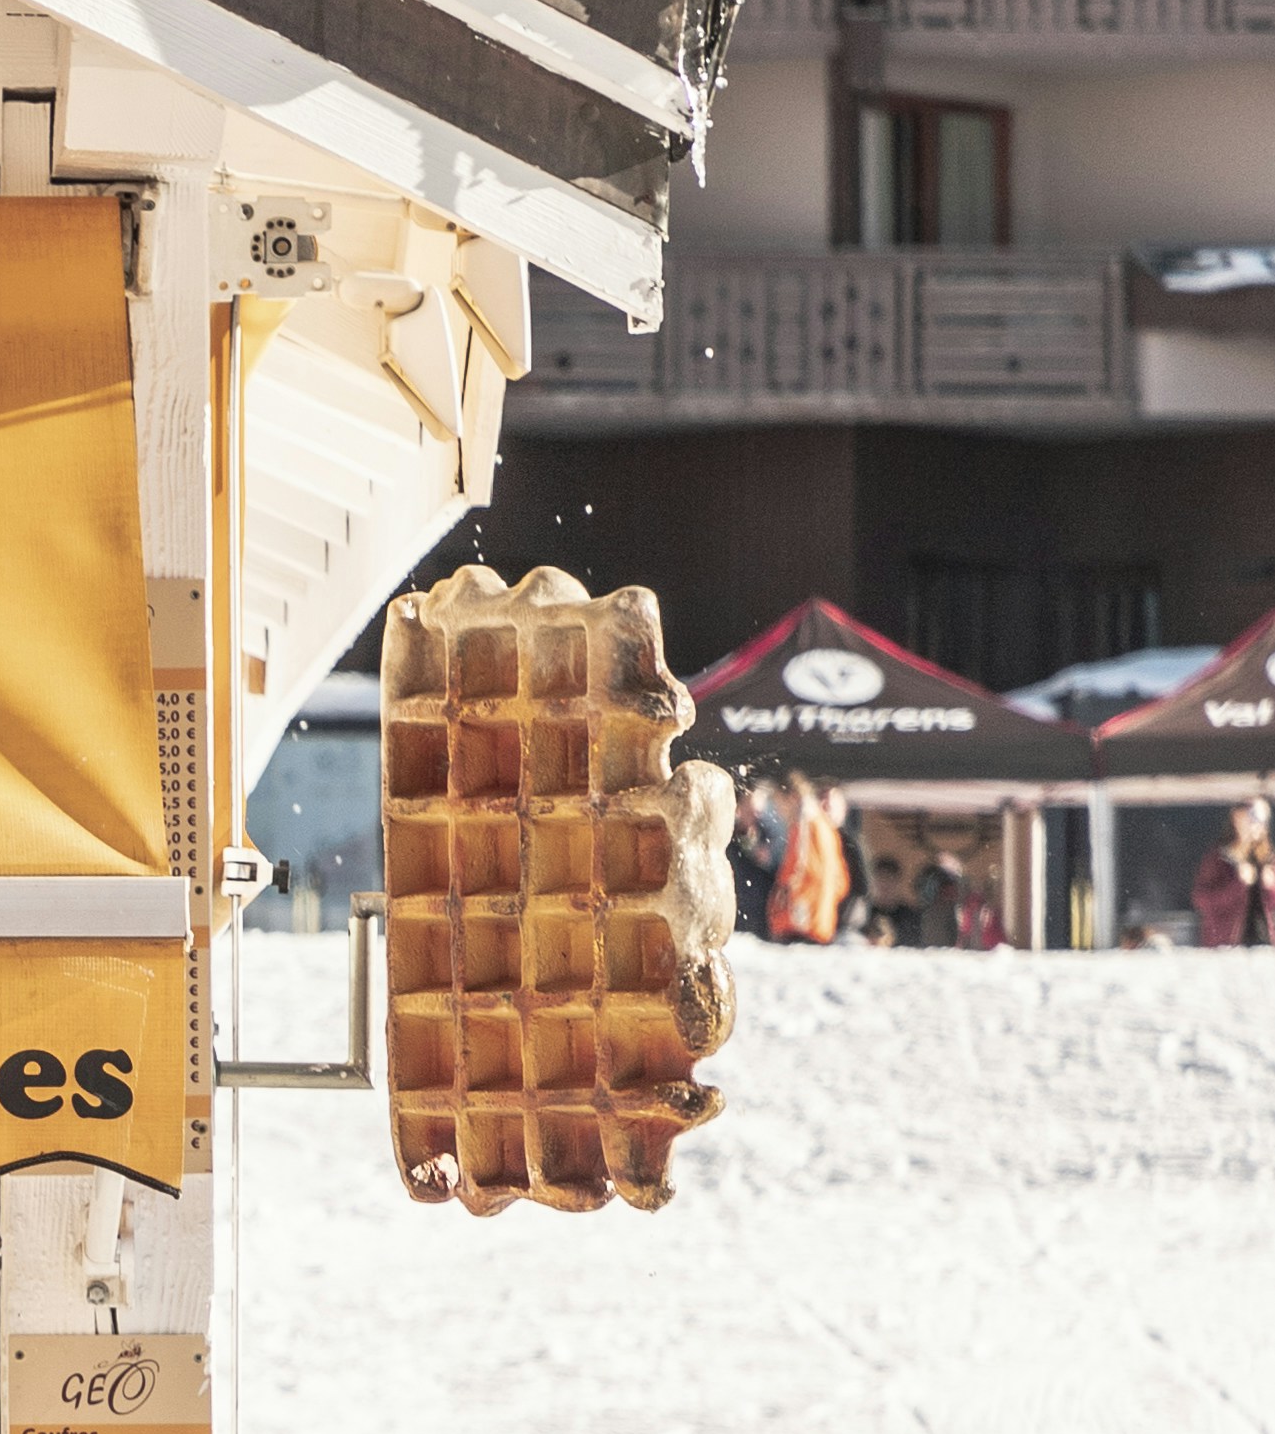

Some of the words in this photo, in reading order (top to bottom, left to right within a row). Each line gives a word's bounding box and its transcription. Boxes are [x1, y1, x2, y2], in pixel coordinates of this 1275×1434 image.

[157, 693, 179, 706] 4,0
[186, 693, 194, 705] €
[158, 711, 179, 724] 5,0
[186, 710, 195, 722] €
[722, 704, 791, 733] Val
[158, 728, 179, 741] 5,0
[187, 728, 195, 739] €
[159, 745, 180, 758] 5,0
[187, 745, 195, 757] €
[187, 762, 195, 774] €
[187, 780, 195, 791] €
[187, 797, 195, 809] €
[188, 814, 195, 826] €
[188, 832, 196, 843] €
[188, 849, 196, 861] €
[188, 866, 197, 878] €
[189, 950, 197, 961] €
[189, 967, 197, 979] €
[190, 984, 197, 996] €
[190, 1002, 198, 1013] €
[190, 1019, 198, 1031] €
[190, 1037, 198, 1048] €
[190, 1054, 198, 1065] €
[191, 1071, 199, 1083] €
[61, 1359, 160, 1415] GEO
